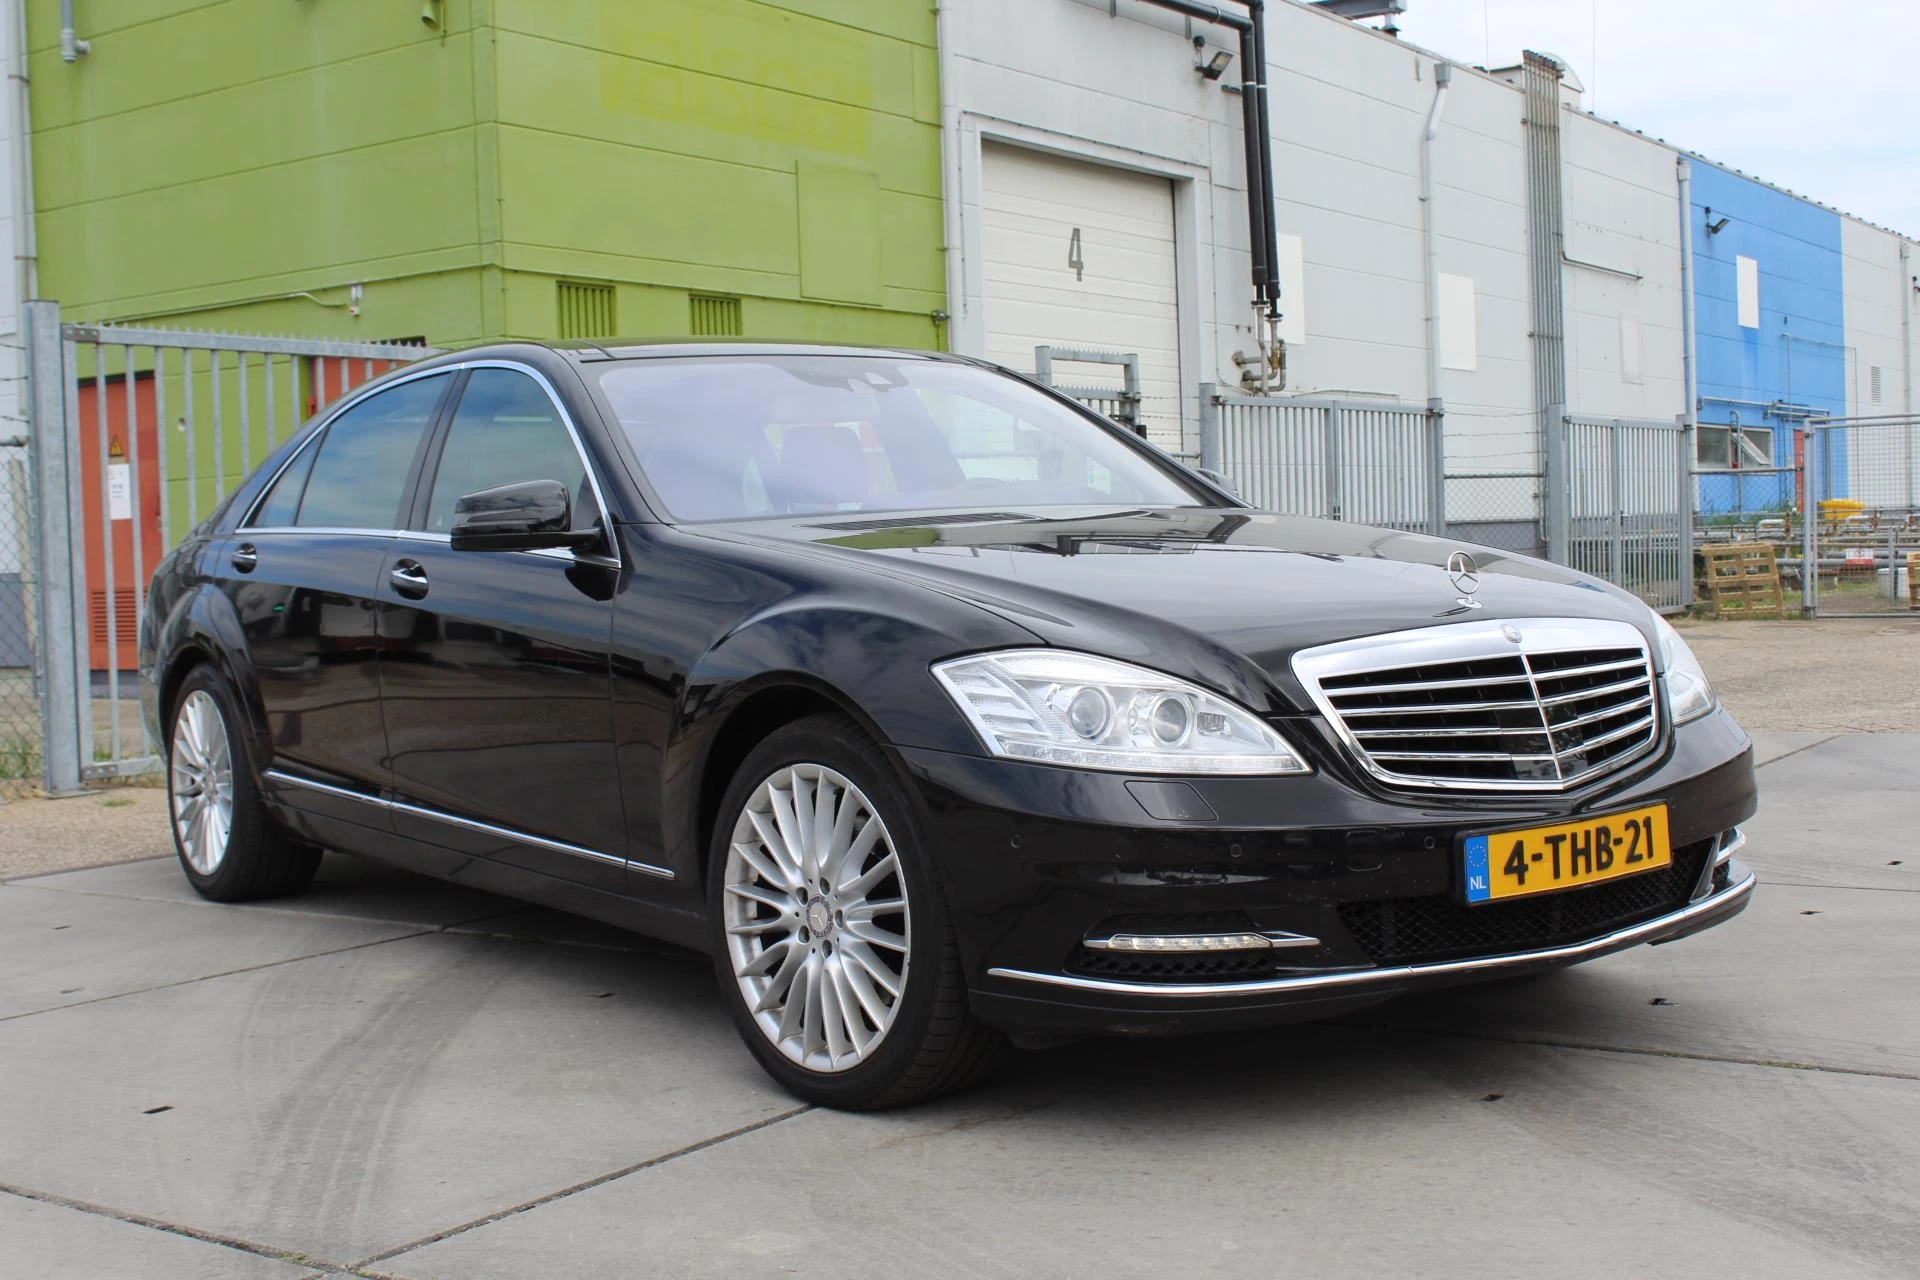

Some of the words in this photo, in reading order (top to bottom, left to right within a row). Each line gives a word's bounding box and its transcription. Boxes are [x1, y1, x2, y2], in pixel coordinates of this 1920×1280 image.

[1068, 227, 1084, 282] 4
[1469, 875, 1487, 890] NL
[1503, 815, 1654, 886] 4-THB-21
